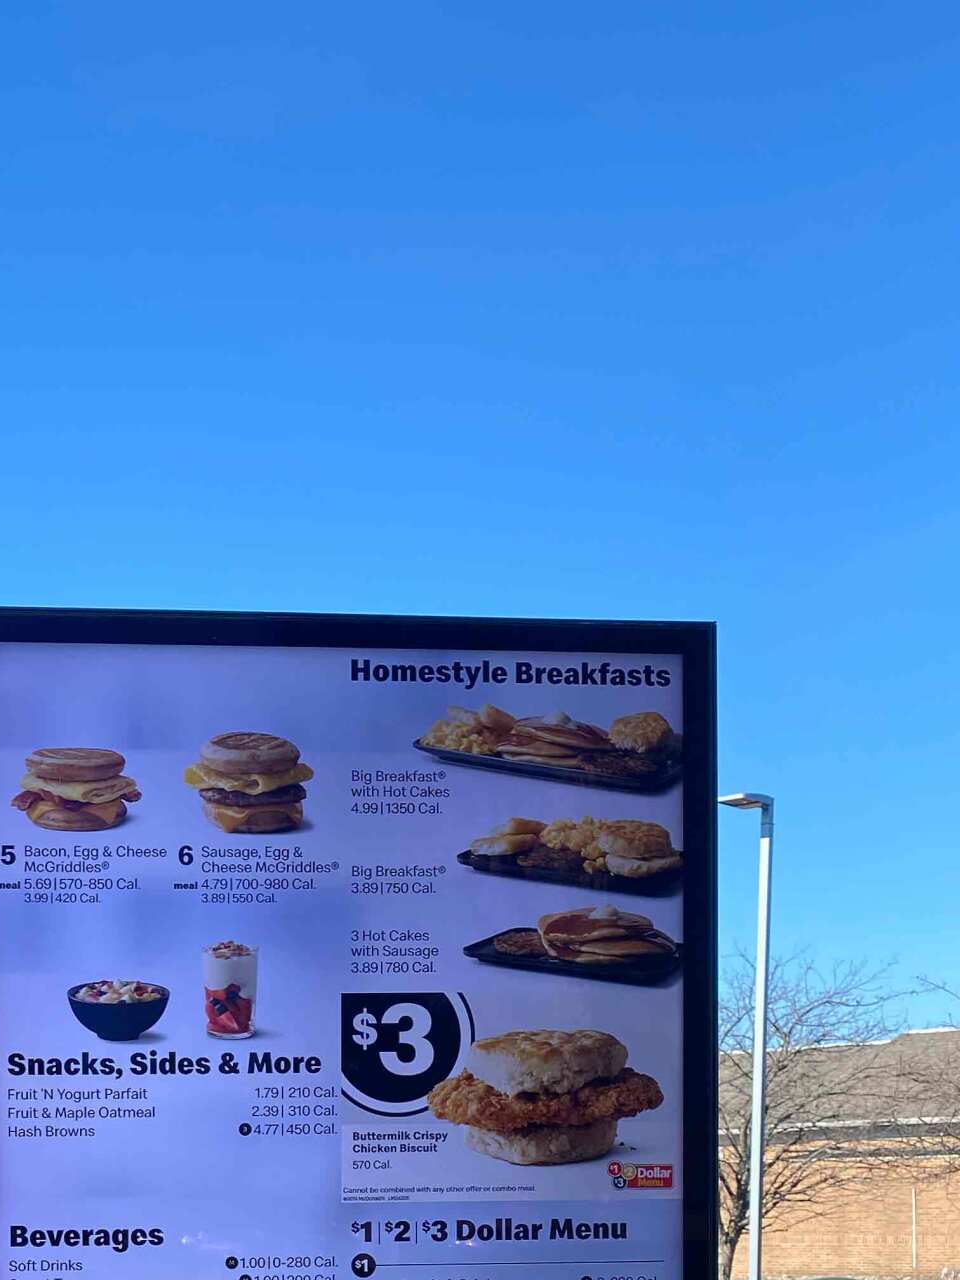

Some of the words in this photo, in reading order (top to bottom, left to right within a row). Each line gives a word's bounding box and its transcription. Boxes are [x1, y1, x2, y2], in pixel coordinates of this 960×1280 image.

[350, 658, 508, 690] Homestyle
[515, 661, 671, 687] Breakfasts
[350, 784, 380, 797] with
[382, 785, 407, 798] Hot
[409, 785, 450, 798] Cakes
[0, 844, 16, 865] 5
[24, 844, 70, 859] Bacon,
[73, 845, 99, 861] Egg
[102, 845, 113, 857] &
[115, 845, 167, 858] Cheese
[178, 845, 194, 866] 6
[201, 845, 261, 861] Sausage,
[264, 845, 290, 861] Egg
[292, 846, 303, 858] &
[350, 929, 359, 942] 3
[362, 929, 386, 942] Hot
[388, 929, 430, 942] Cakes
[351, 1002, 436, 1077] $3
[7, 1051, 123, 1080] Snacks,
[129, 1049, 211, 1076] Sides
[218, 1052, 240, 1075] &
[247, 1051, 321, 1074] More
[7, 1088, 38, 1101] Fruit
[56, 1088, 101, 1103] Yogurt
[104, 1087, 148, 1100] Parfait
[7, 1106, 39, 1119] Fruit
[41, 1107, 52, 1119] &
[54, 1105, 96, 1121] Maple
[98, 1105, 156, 1119] Oatmeal
[352, 1130, 411, 1141] Buttermilk
[412, 1130, 448, 1144] Crispy
[352, 1143, 397, 1153] Chicken
[399, 1142, 437, 1153] Biscuit
[352, 1159, 371, 1170] 570
[372, 1159, 392, 1170] Cal.
[637, 1166, 672, 1178] Dollar
[456, 1218, 543, 1241] Dollar
[549, 1218, 627, 1240] Menu
[9, 1225, 164, 1253] Beverages
[8, 1259, 37, 1272] Soft
[40, 1259, 83, 1271] Drinks
